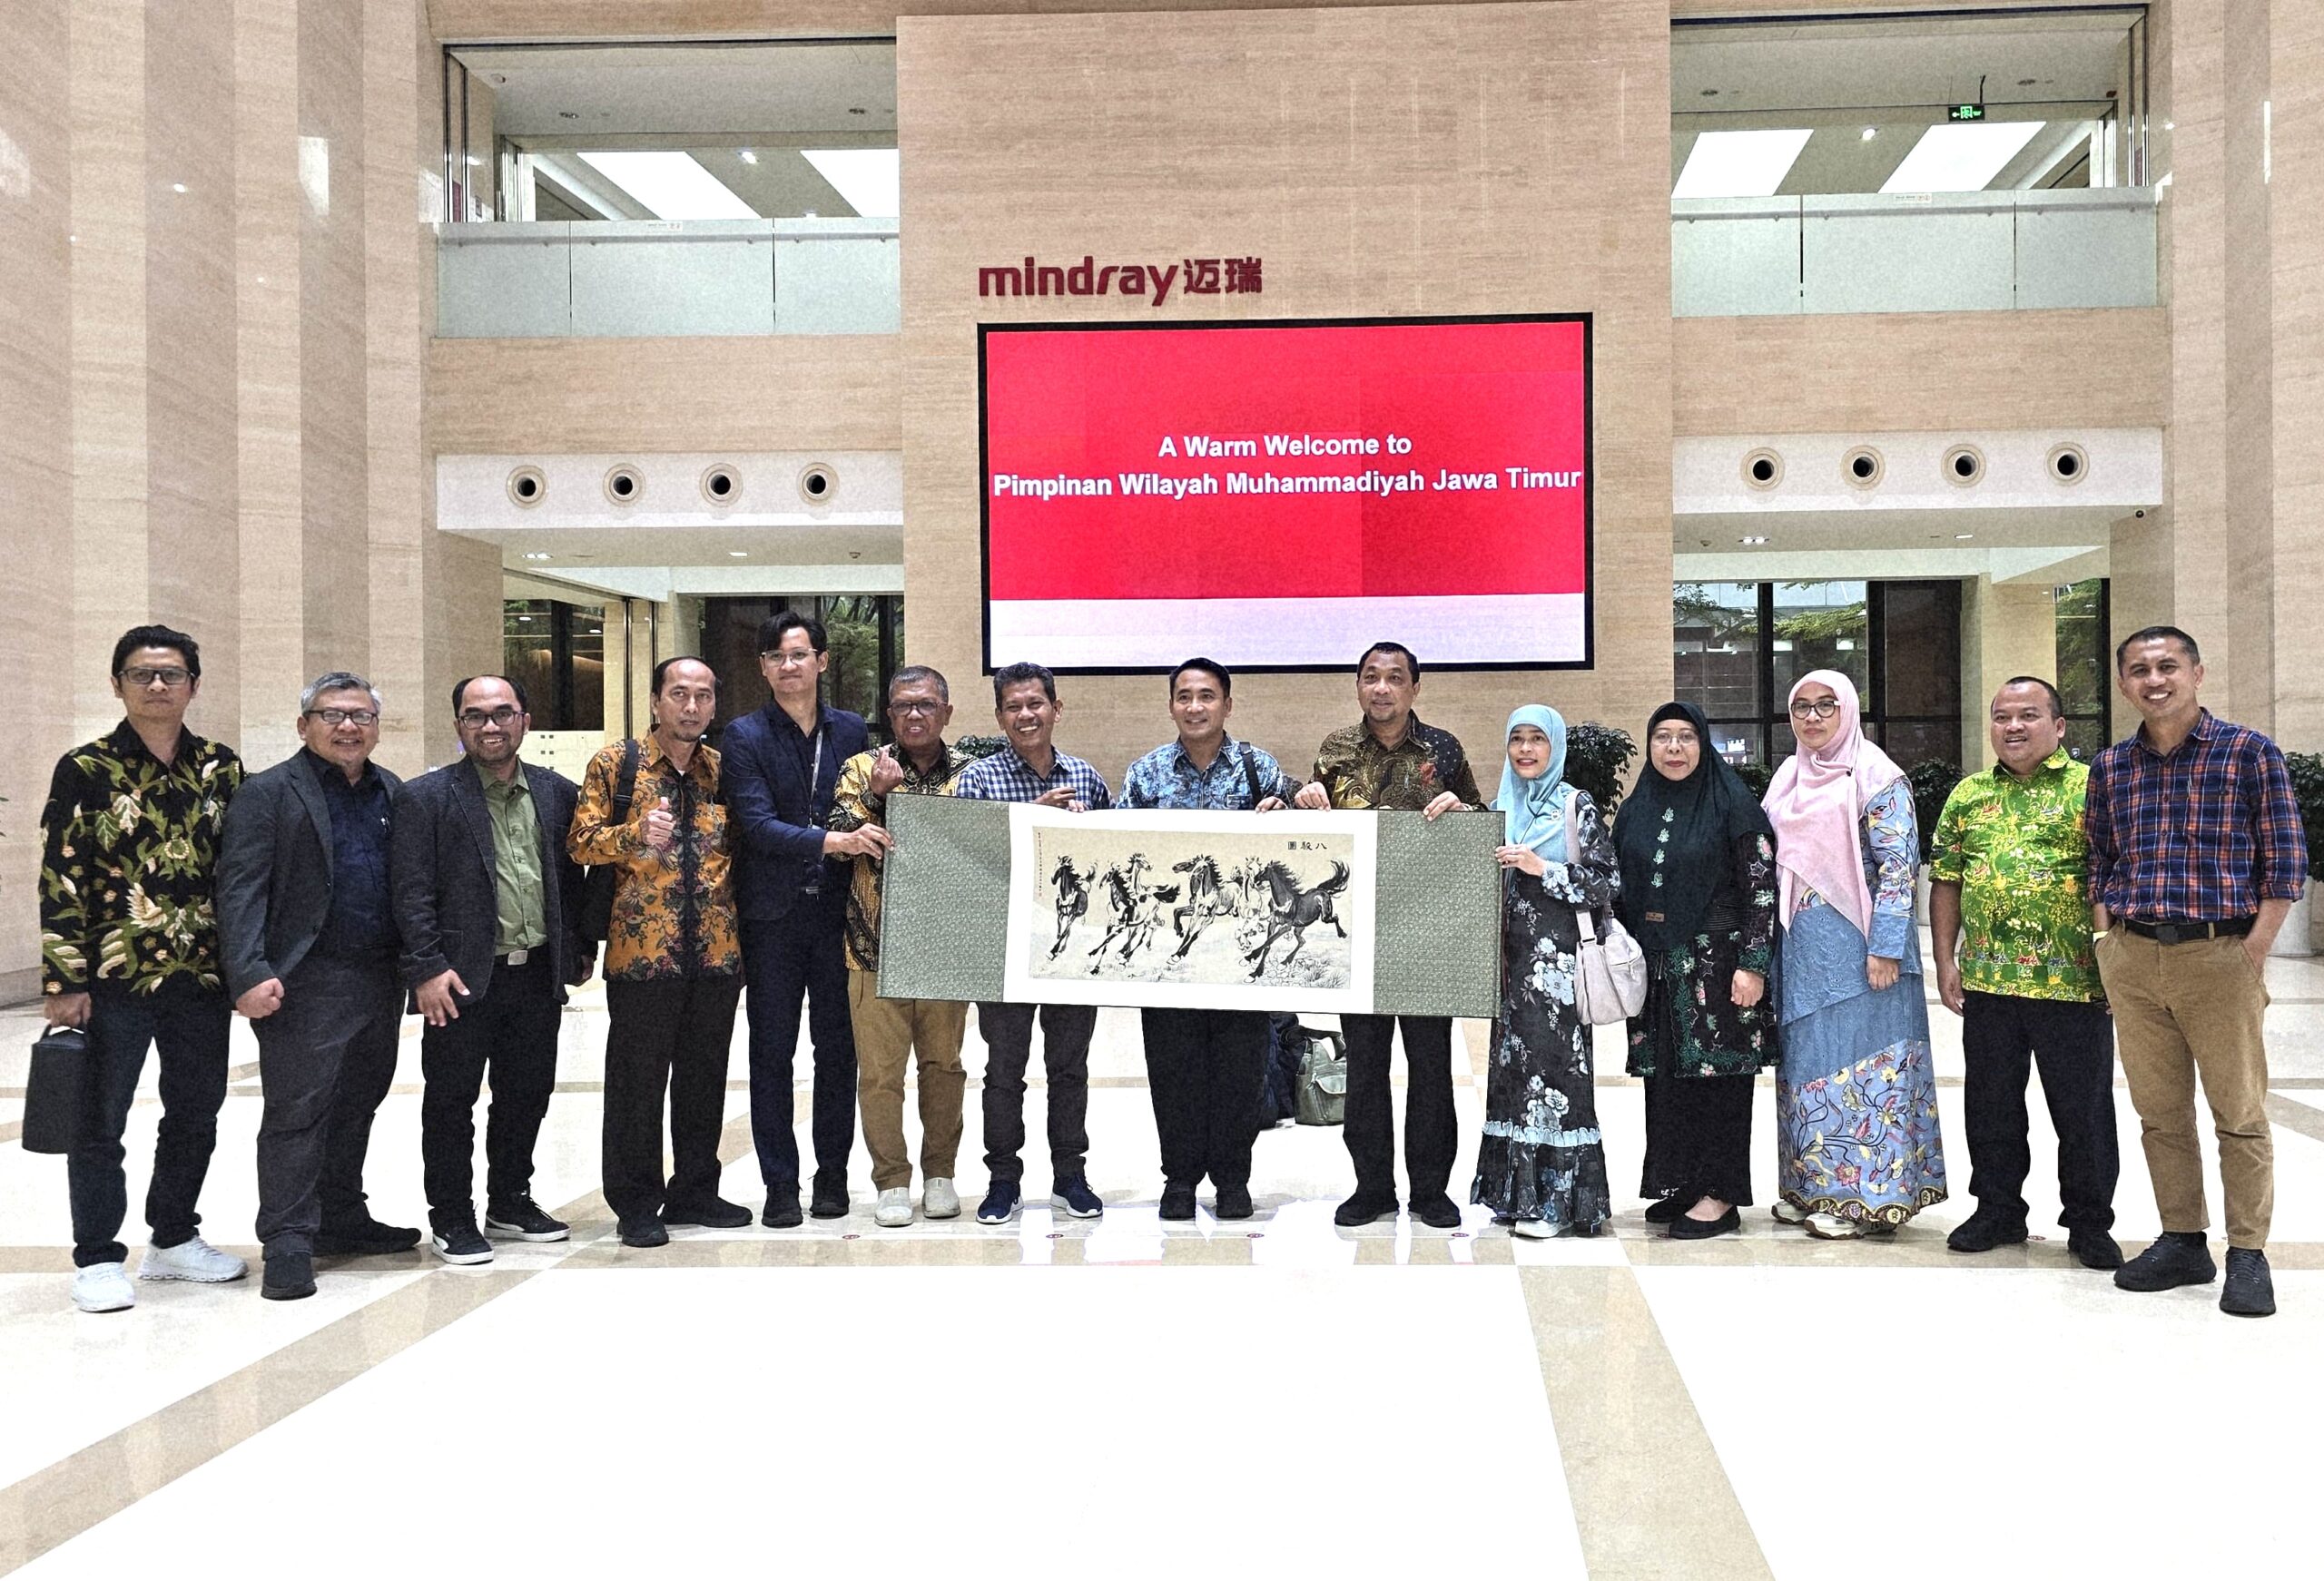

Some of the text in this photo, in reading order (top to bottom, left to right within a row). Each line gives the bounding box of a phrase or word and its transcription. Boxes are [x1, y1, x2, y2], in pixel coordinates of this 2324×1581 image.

[979, 255, 1263, 307] mindray 迈瑞
[1157, 434, 1413, 457] A Warm Welcome to
[993, 466, 1582, 501] Pimpinan Wilayah Muhammadiyah Jawa Timur
